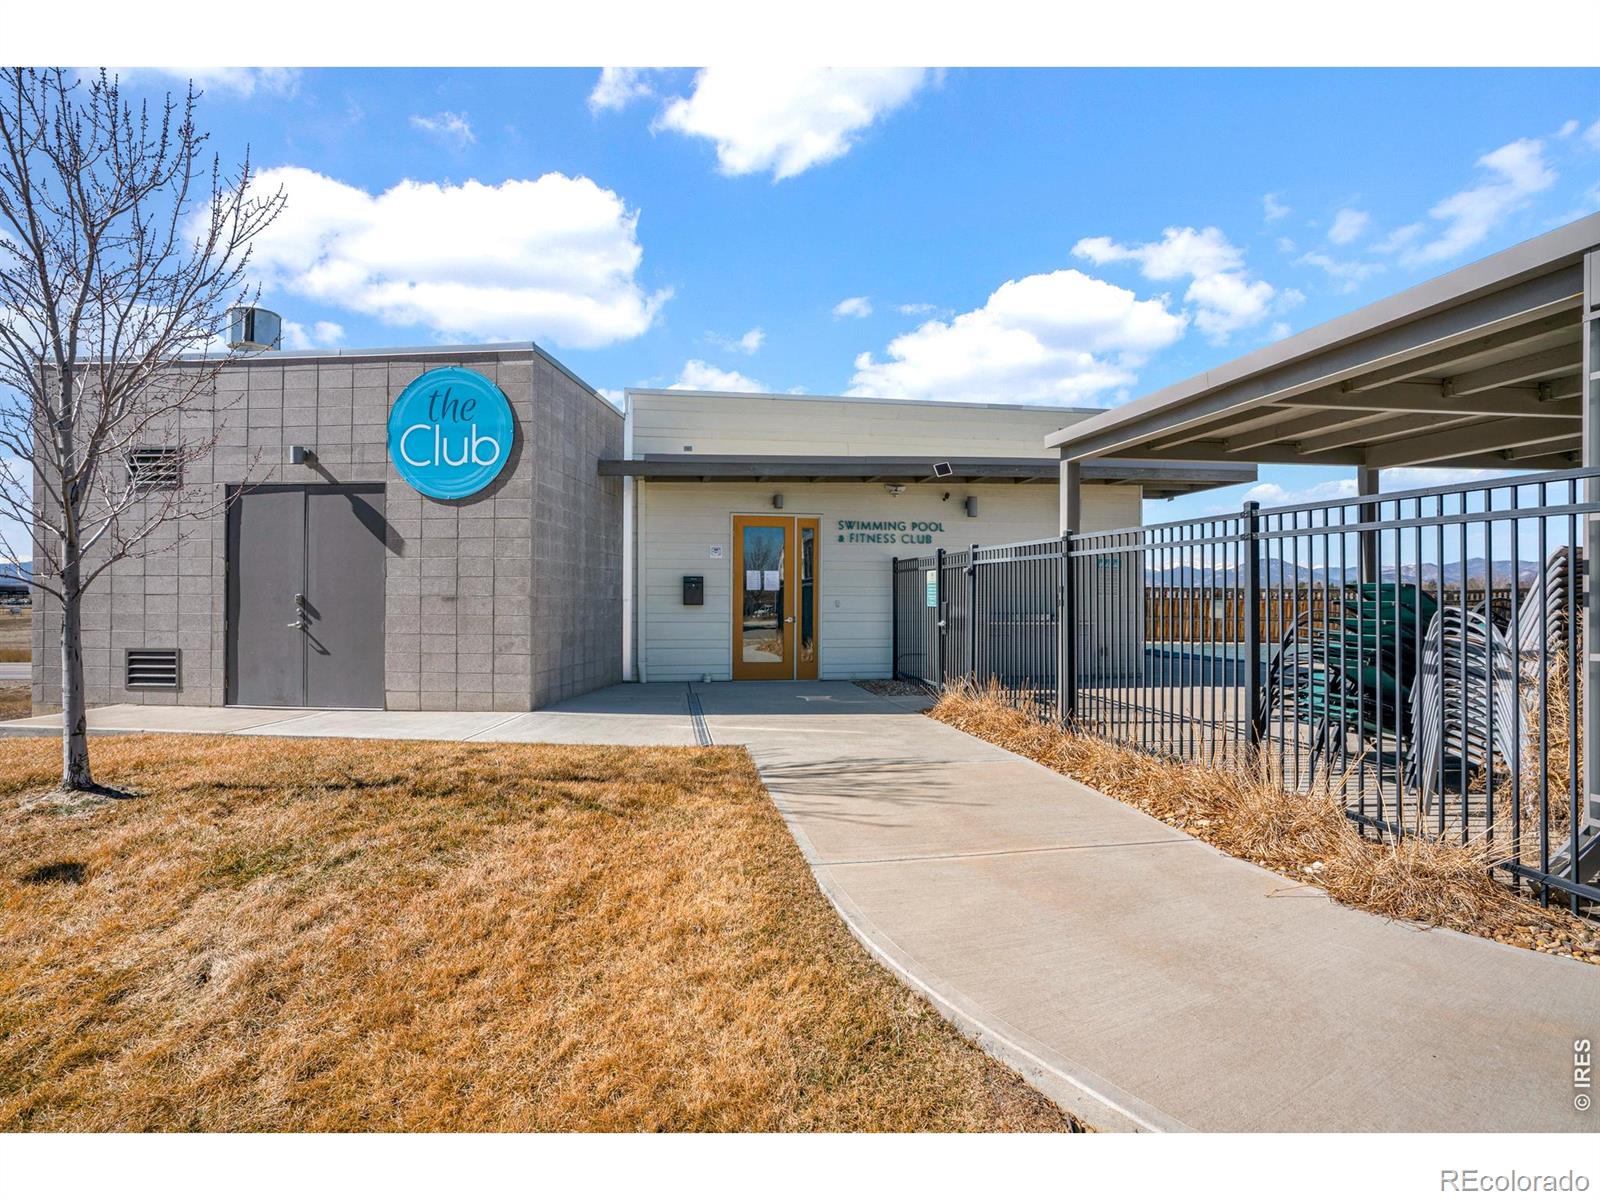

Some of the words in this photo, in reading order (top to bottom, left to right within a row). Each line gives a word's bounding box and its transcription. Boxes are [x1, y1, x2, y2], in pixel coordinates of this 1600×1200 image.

[428, 386, 477, 424] the
[400, 423, 500, 467] Club
[838, 520, 906, 531] SWIMMING
[911, 521, 945, 532] POOL
[838, 535, 845, 543] &
[849, 533, 896, 544] FITNESS
[901, 534, 932, 544] CLUB
